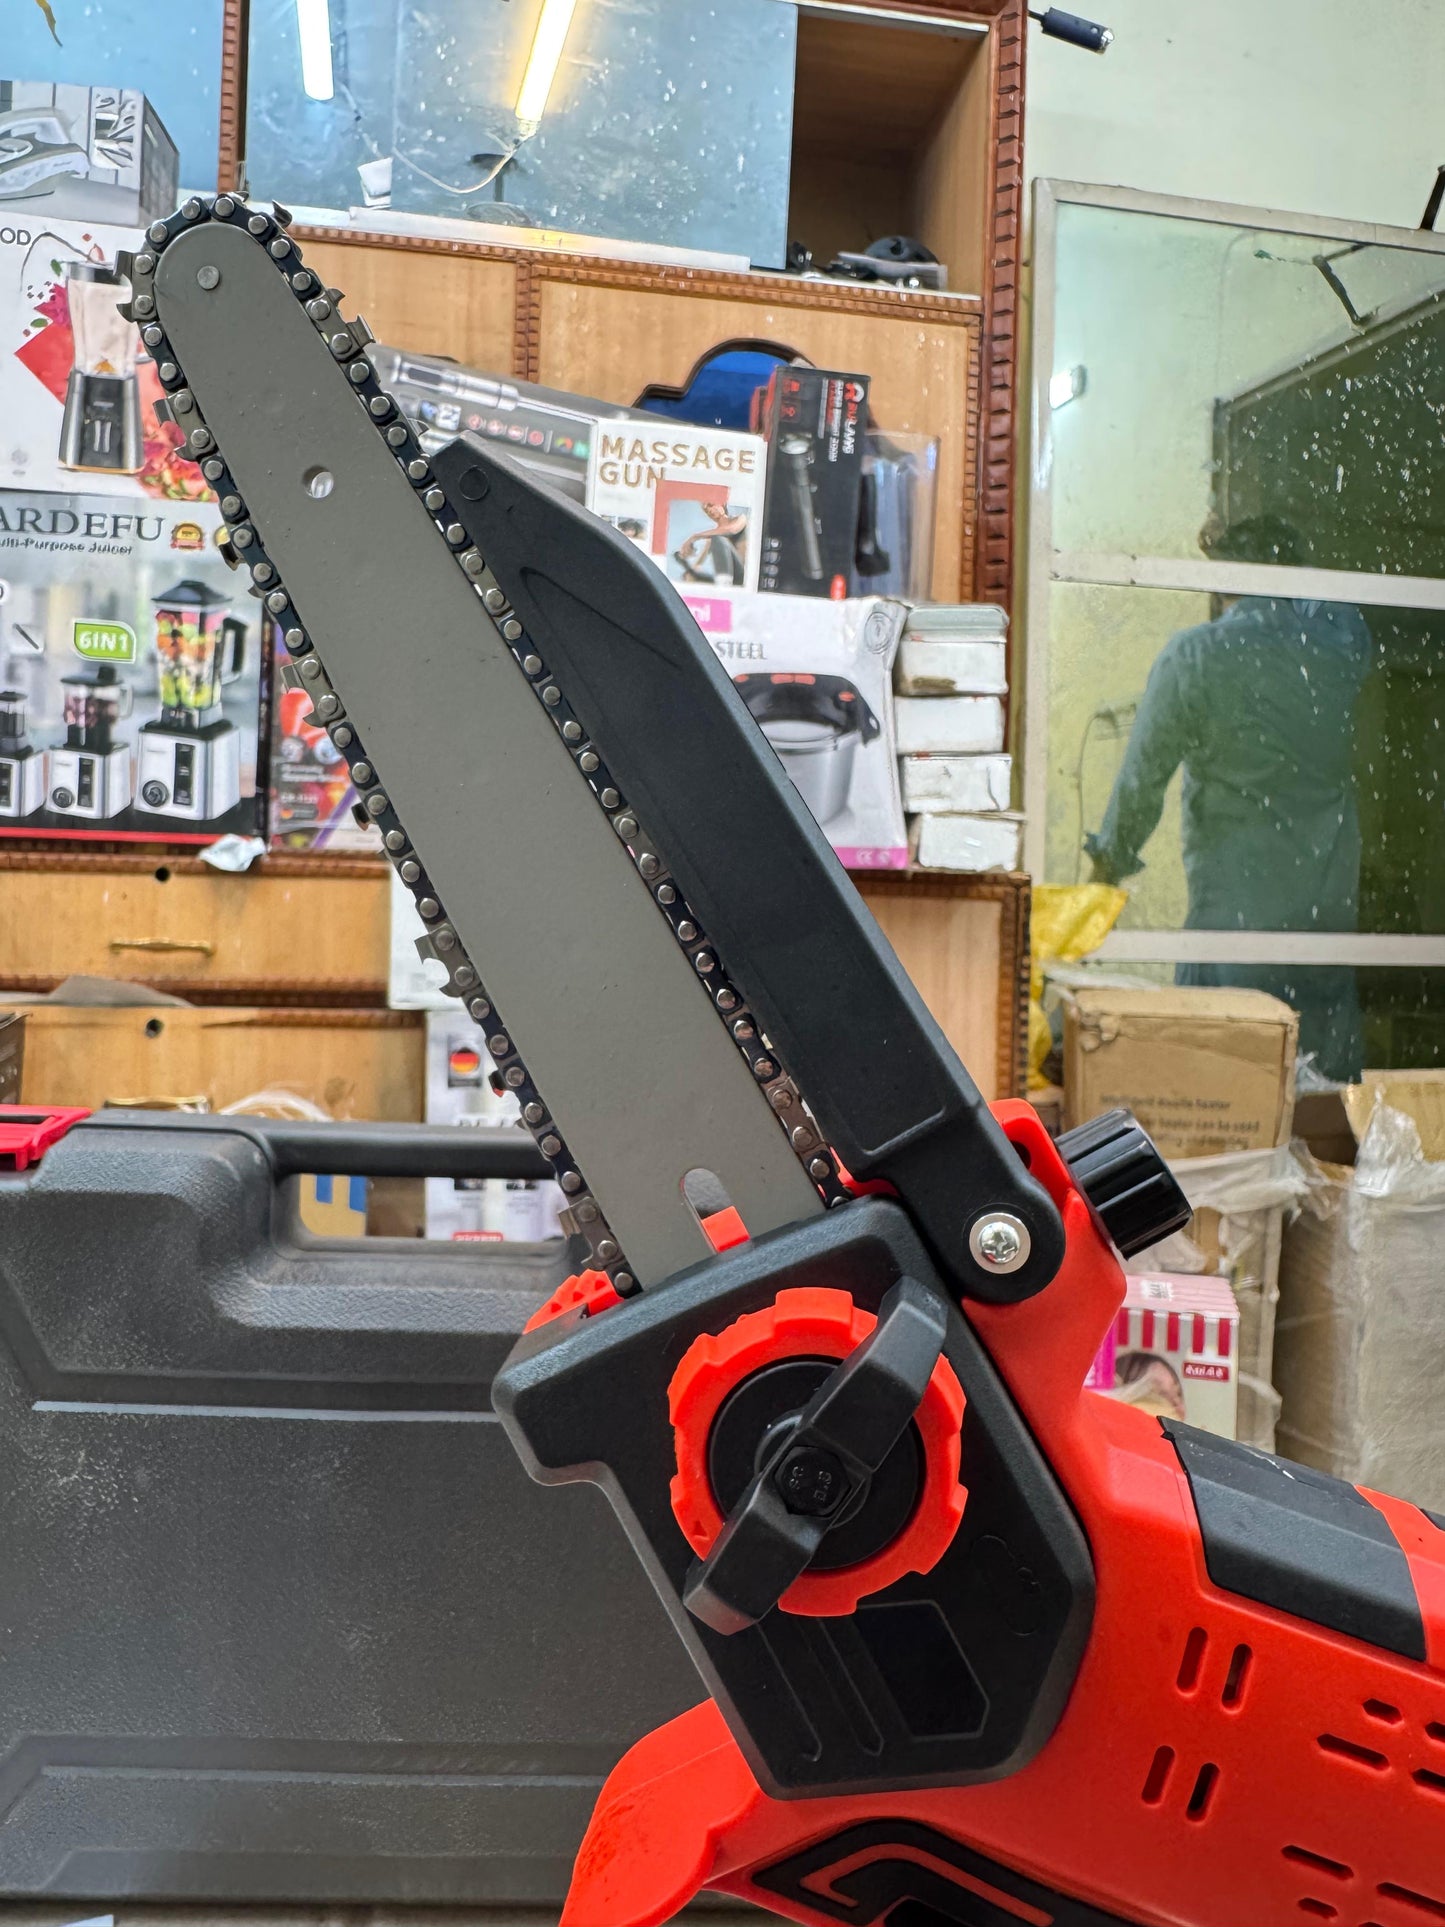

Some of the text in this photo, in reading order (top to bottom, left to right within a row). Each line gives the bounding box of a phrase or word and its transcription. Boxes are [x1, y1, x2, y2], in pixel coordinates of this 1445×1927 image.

[0, 228, 31, 246] OD
[601, 434, 756, 473] MASSAGE
[599, 462, 665, 488] GUN
[88, 543, 133, 556] Juicer
[79, 633, 130, 653] 6IN1
[715, 641, 768, 660] STEEL
